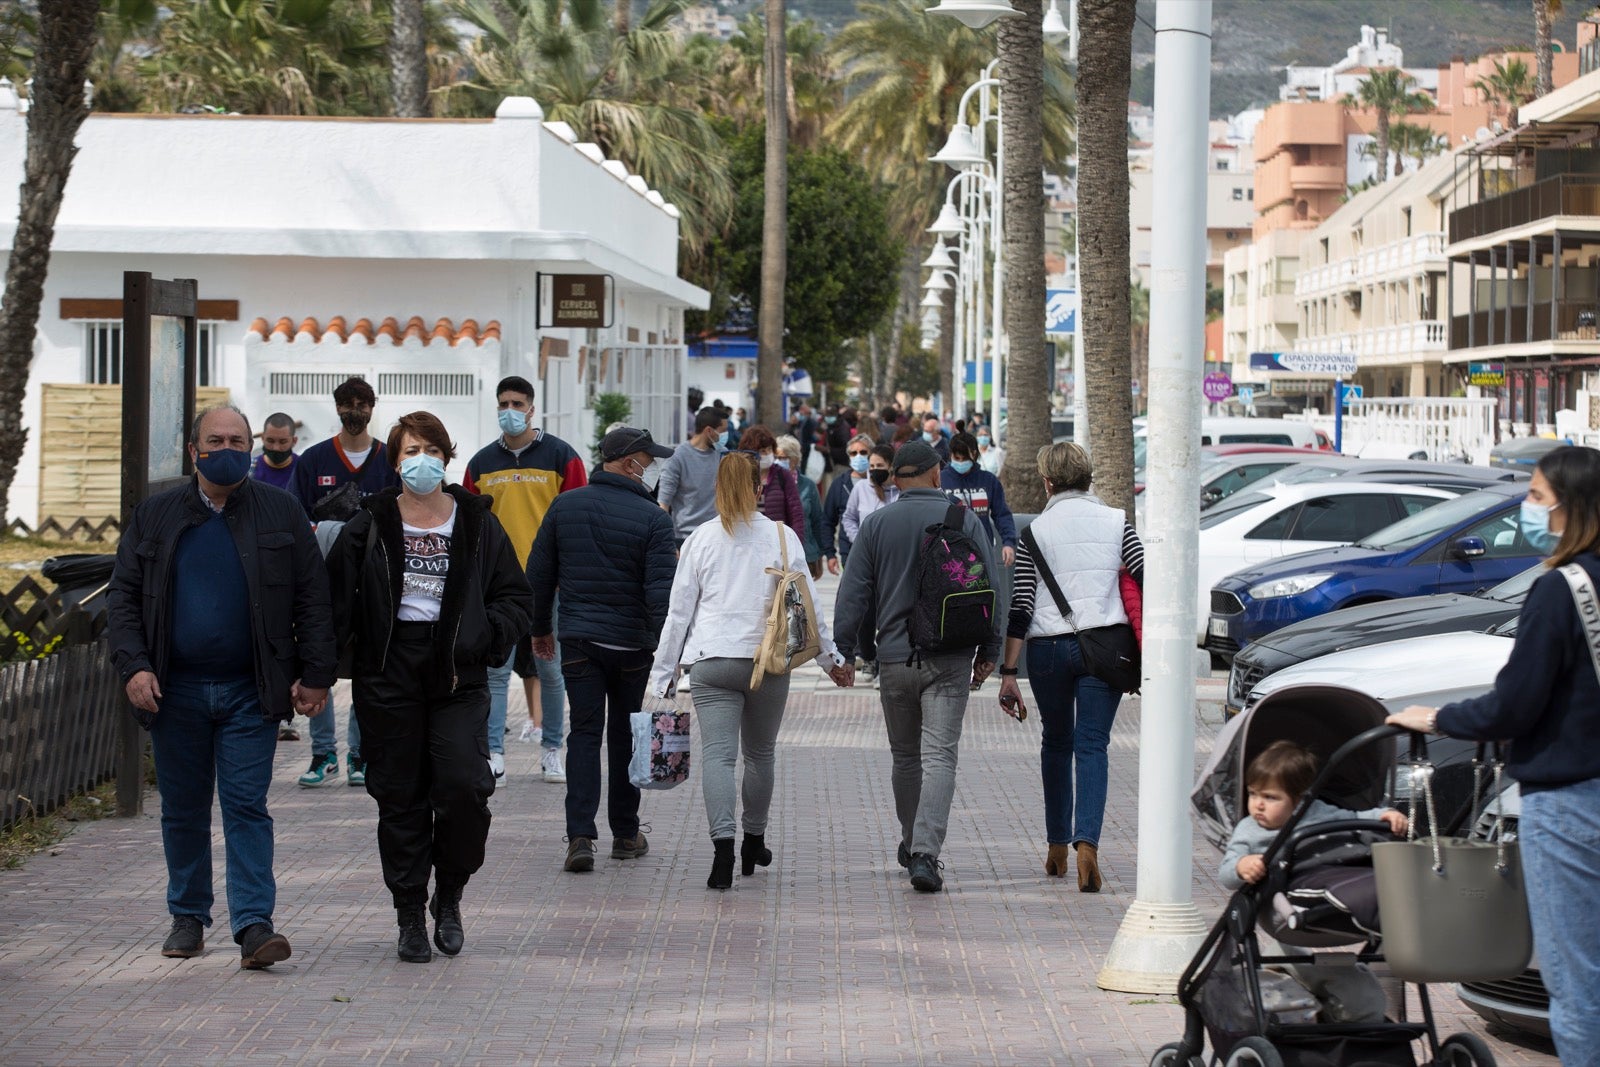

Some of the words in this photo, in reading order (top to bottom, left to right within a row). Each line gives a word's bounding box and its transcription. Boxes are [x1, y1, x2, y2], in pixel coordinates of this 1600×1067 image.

[560, 300, 597, 309] CERVEZAS
[557, 310, 599, 319] ALHAMBRA
[1284, 354, 1314, 362] ESPACIO
[1315, 355, 1356, 364] DISPONIBLE
[1300, 363, 1318, 371] 677
[1320, 364, 1337, 372] 244
[1340, 364, 1357, 373] 706
[1205, 383, 1230, 391] STOP
[522, 475, 547, 483] KANI
[404, 537, 451, 552] SPAR
